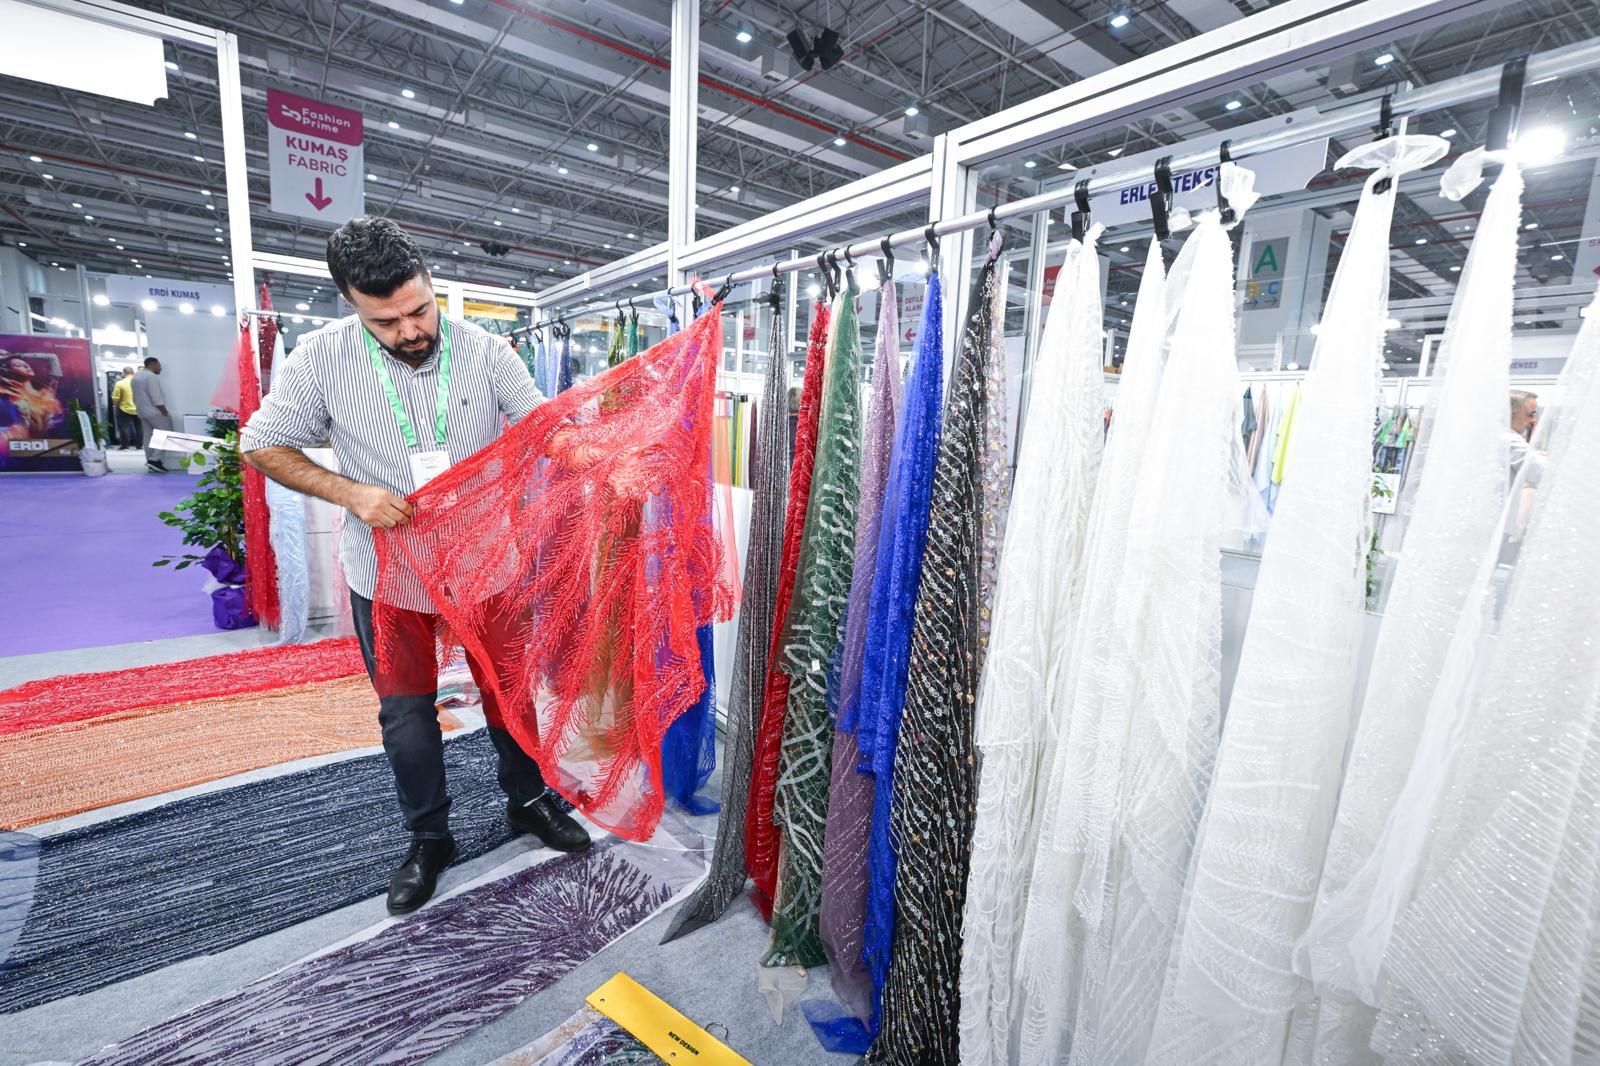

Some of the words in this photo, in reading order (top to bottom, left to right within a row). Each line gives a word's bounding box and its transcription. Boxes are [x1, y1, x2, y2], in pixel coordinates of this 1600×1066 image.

[302, 108, 351, 128] Fashion
[302, 117, 339, 133] Prime
[286, 135, 349, 163] KUMAŞ
[288, 153, 347, 177] FABRIC
[1254, 244, 1278, 273] A
[1268, 281, 1280, 295] C
[9, 439, 49, 451] ERDİ
[668, 1031, 681, 1044] NEW
[679, 1040, 700, 1056] DESIGN
